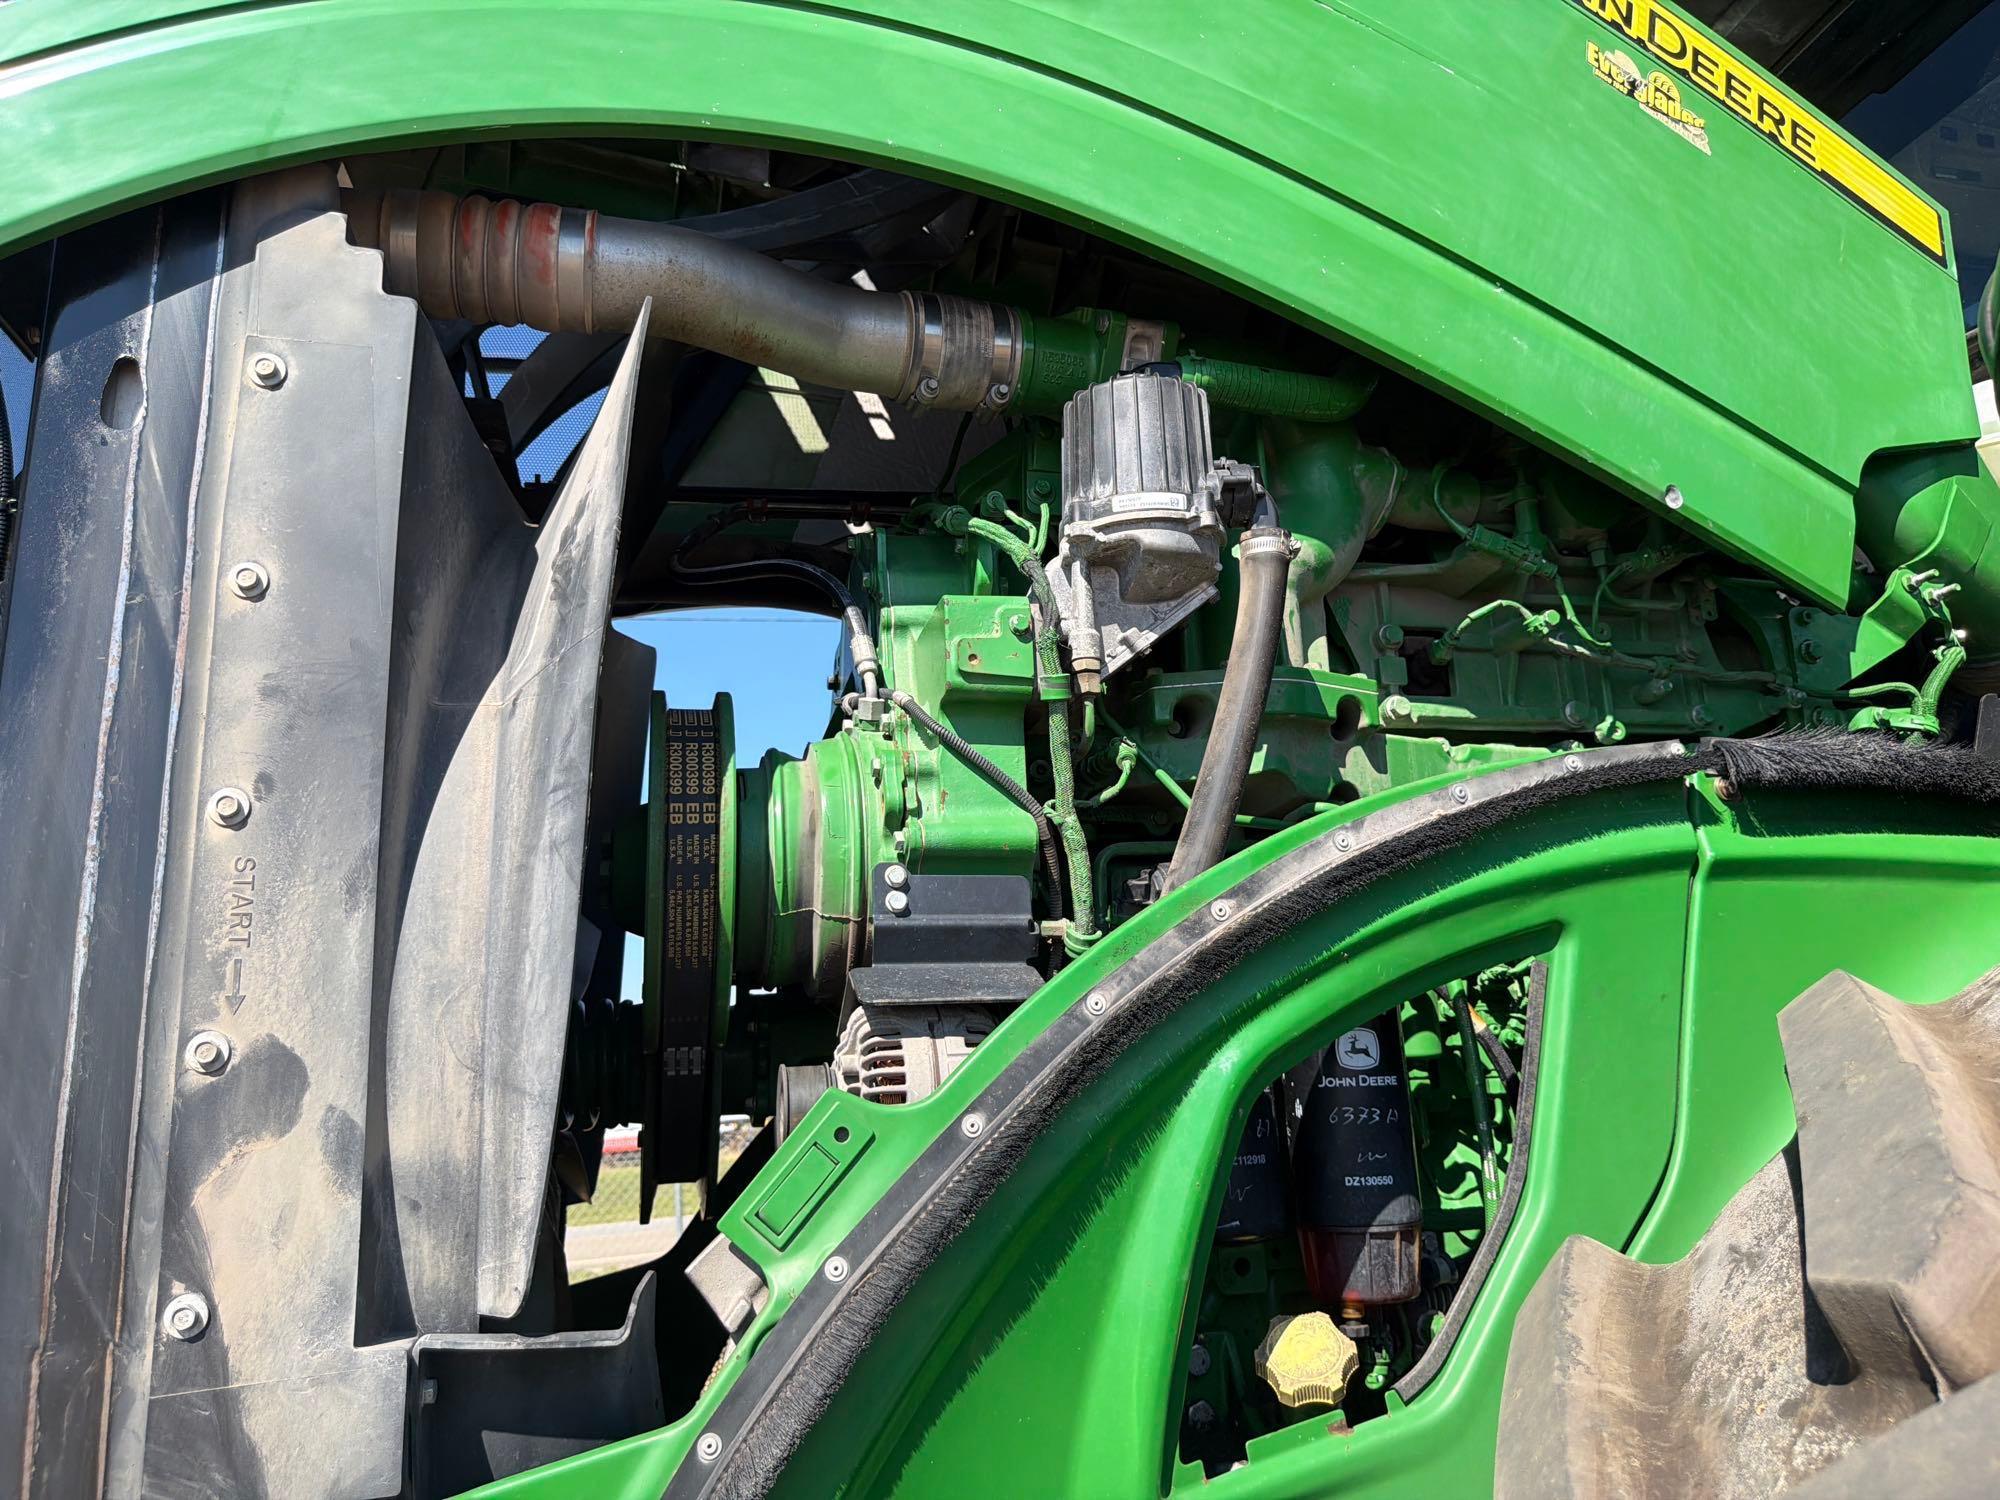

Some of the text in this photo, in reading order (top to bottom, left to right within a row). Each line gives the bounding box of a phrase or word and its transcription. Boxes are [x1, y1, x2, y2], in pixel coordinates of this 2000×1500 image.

[1649, 8, 1817, 163] DEERE
[669, 742, 683, 825] R300399 EB
[686, 742, 700, 825] R300399 EB
[702, 742, 715, 824] R300399 EB
[669, 839, 677, 860] U.S.A.
[228, 856, 257, 949] START
[1318, 1074, 1398, 1088] JOHN DEERE
[1344, 1175, 1394, 1187] DZ130550
